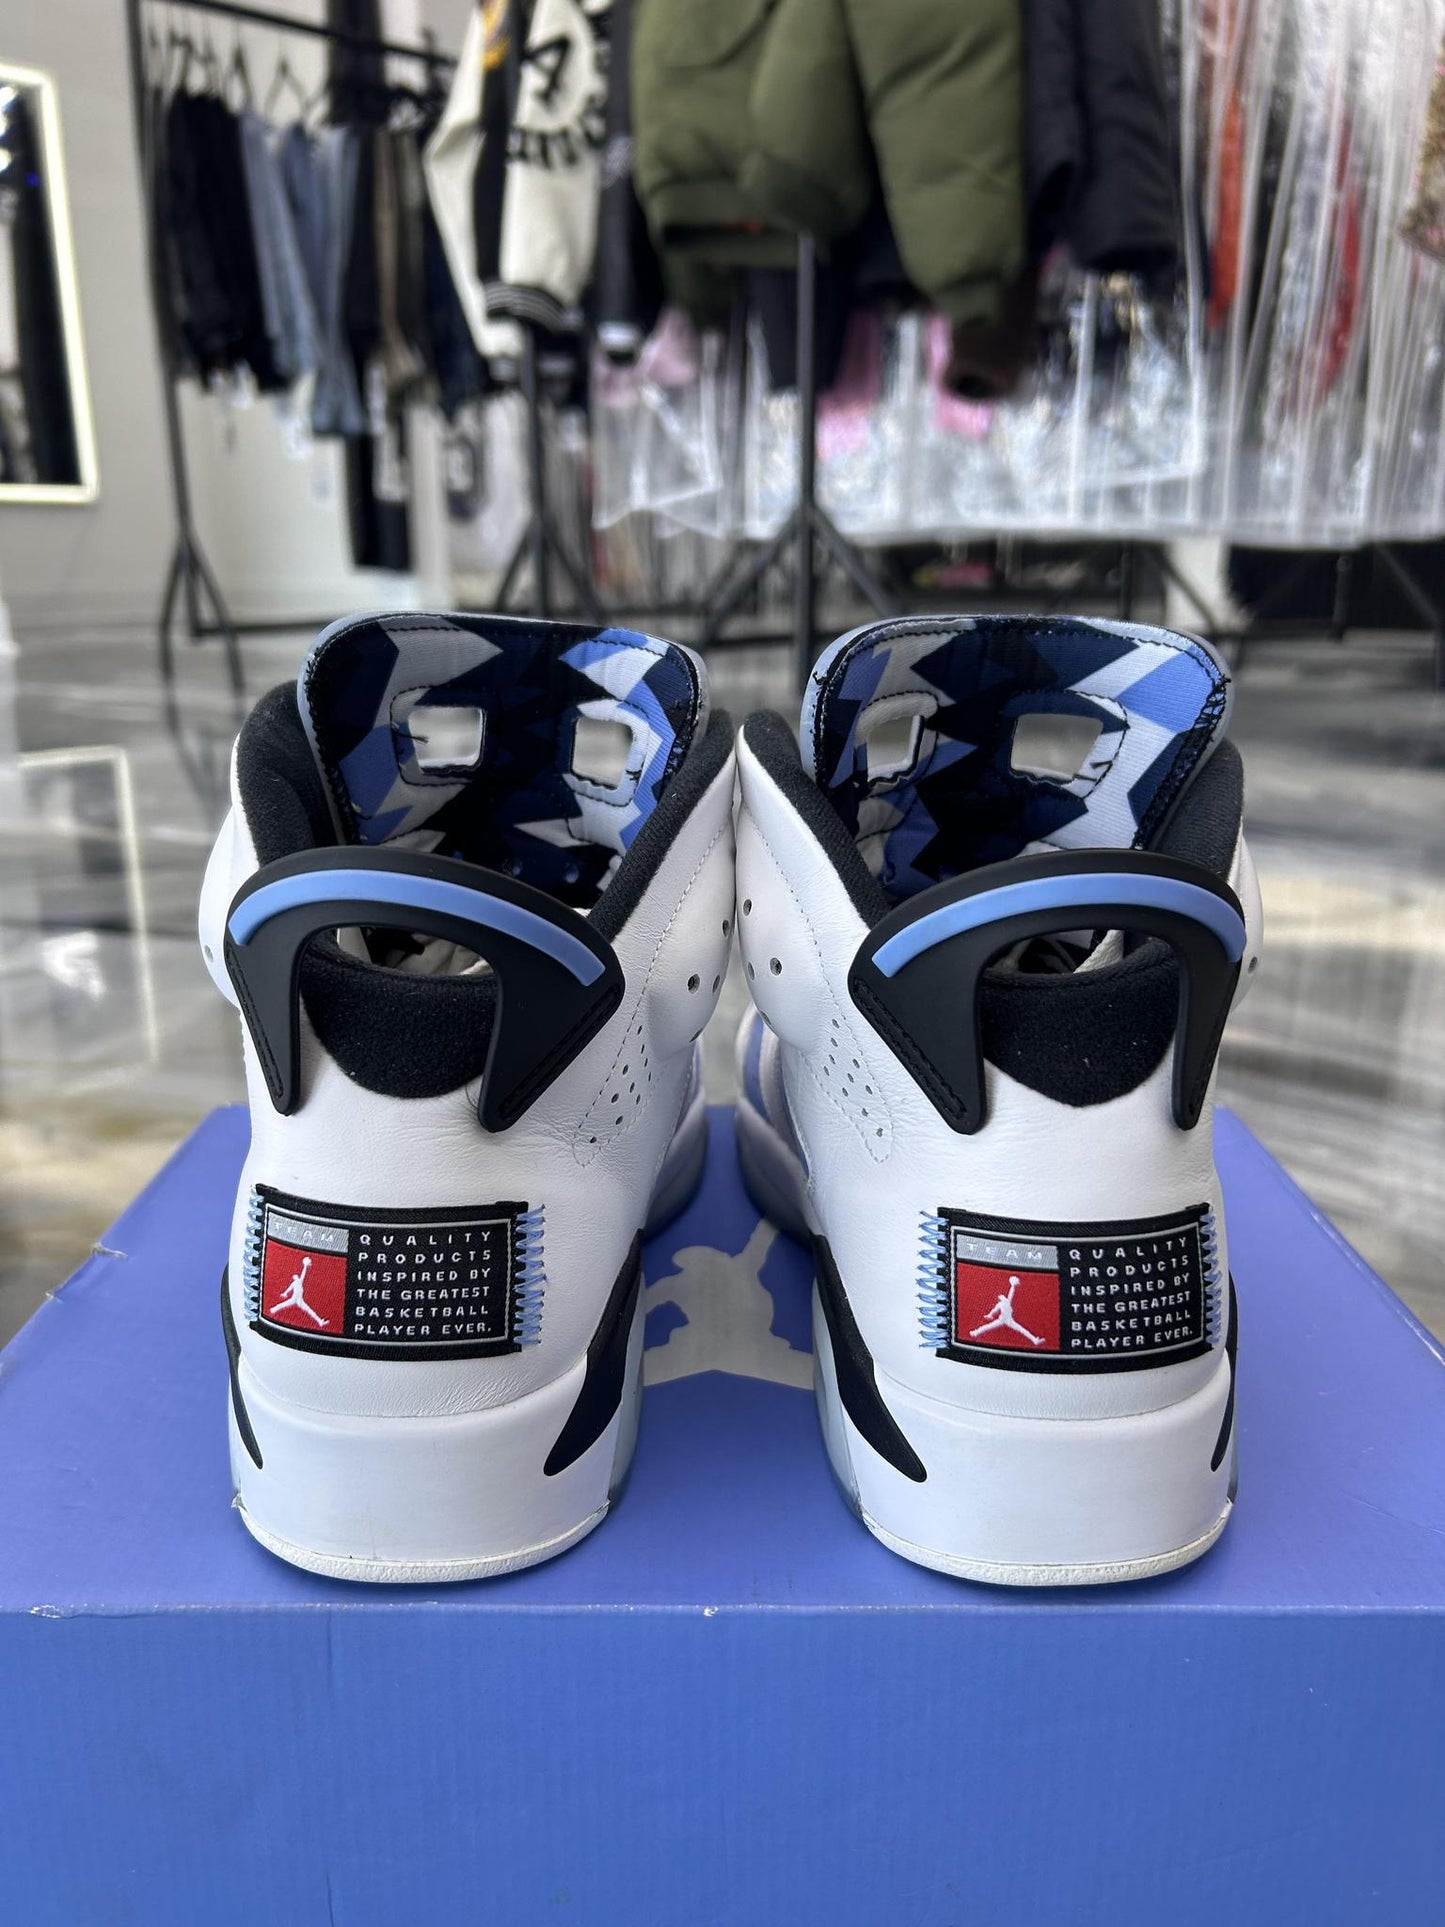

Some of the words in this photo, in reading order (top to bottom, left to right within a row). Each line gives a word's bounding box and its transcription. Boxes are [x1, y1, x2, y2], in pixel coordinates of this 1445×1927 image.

[274, 1222, 334, 1242] TEAM
[360, 1232, 490, 1246] QUALITY
[358, 1250, 491, 1264] PRODUCTS
[967, 1243, 1042, 1260] TEAM
[1069, 1237, 1186, 1260] QUALITY
[358, 1270, 458, 1282] INSPIRED
[470, 1268, 490, 1278] BY
[1070, 1256, 1188, 1277] PRODUCTS
[357, 1289, 390, 1300] THE
[401, 1286, 490, 1300] GREATEST
[1071, 1280, 1165, 1295] INSPIRED
[1174, 1273, 1189, 1286] BY
[1072, 1303, 1106, 1313] THE
[1115, 1291, 1190, 1312] GREATEST
[356, 1305, 488, 1318] BASKETBALL
[354, 1324, 430, 1335] PLAYER
[442, 1323, 491, 1334] EVER.
[1071, 1311, 1190, 1331] BASKETBALL
[1071, 1336, 1144, 1348] PLAYER
[1154, 1326, 1192, 1342] EVER.
